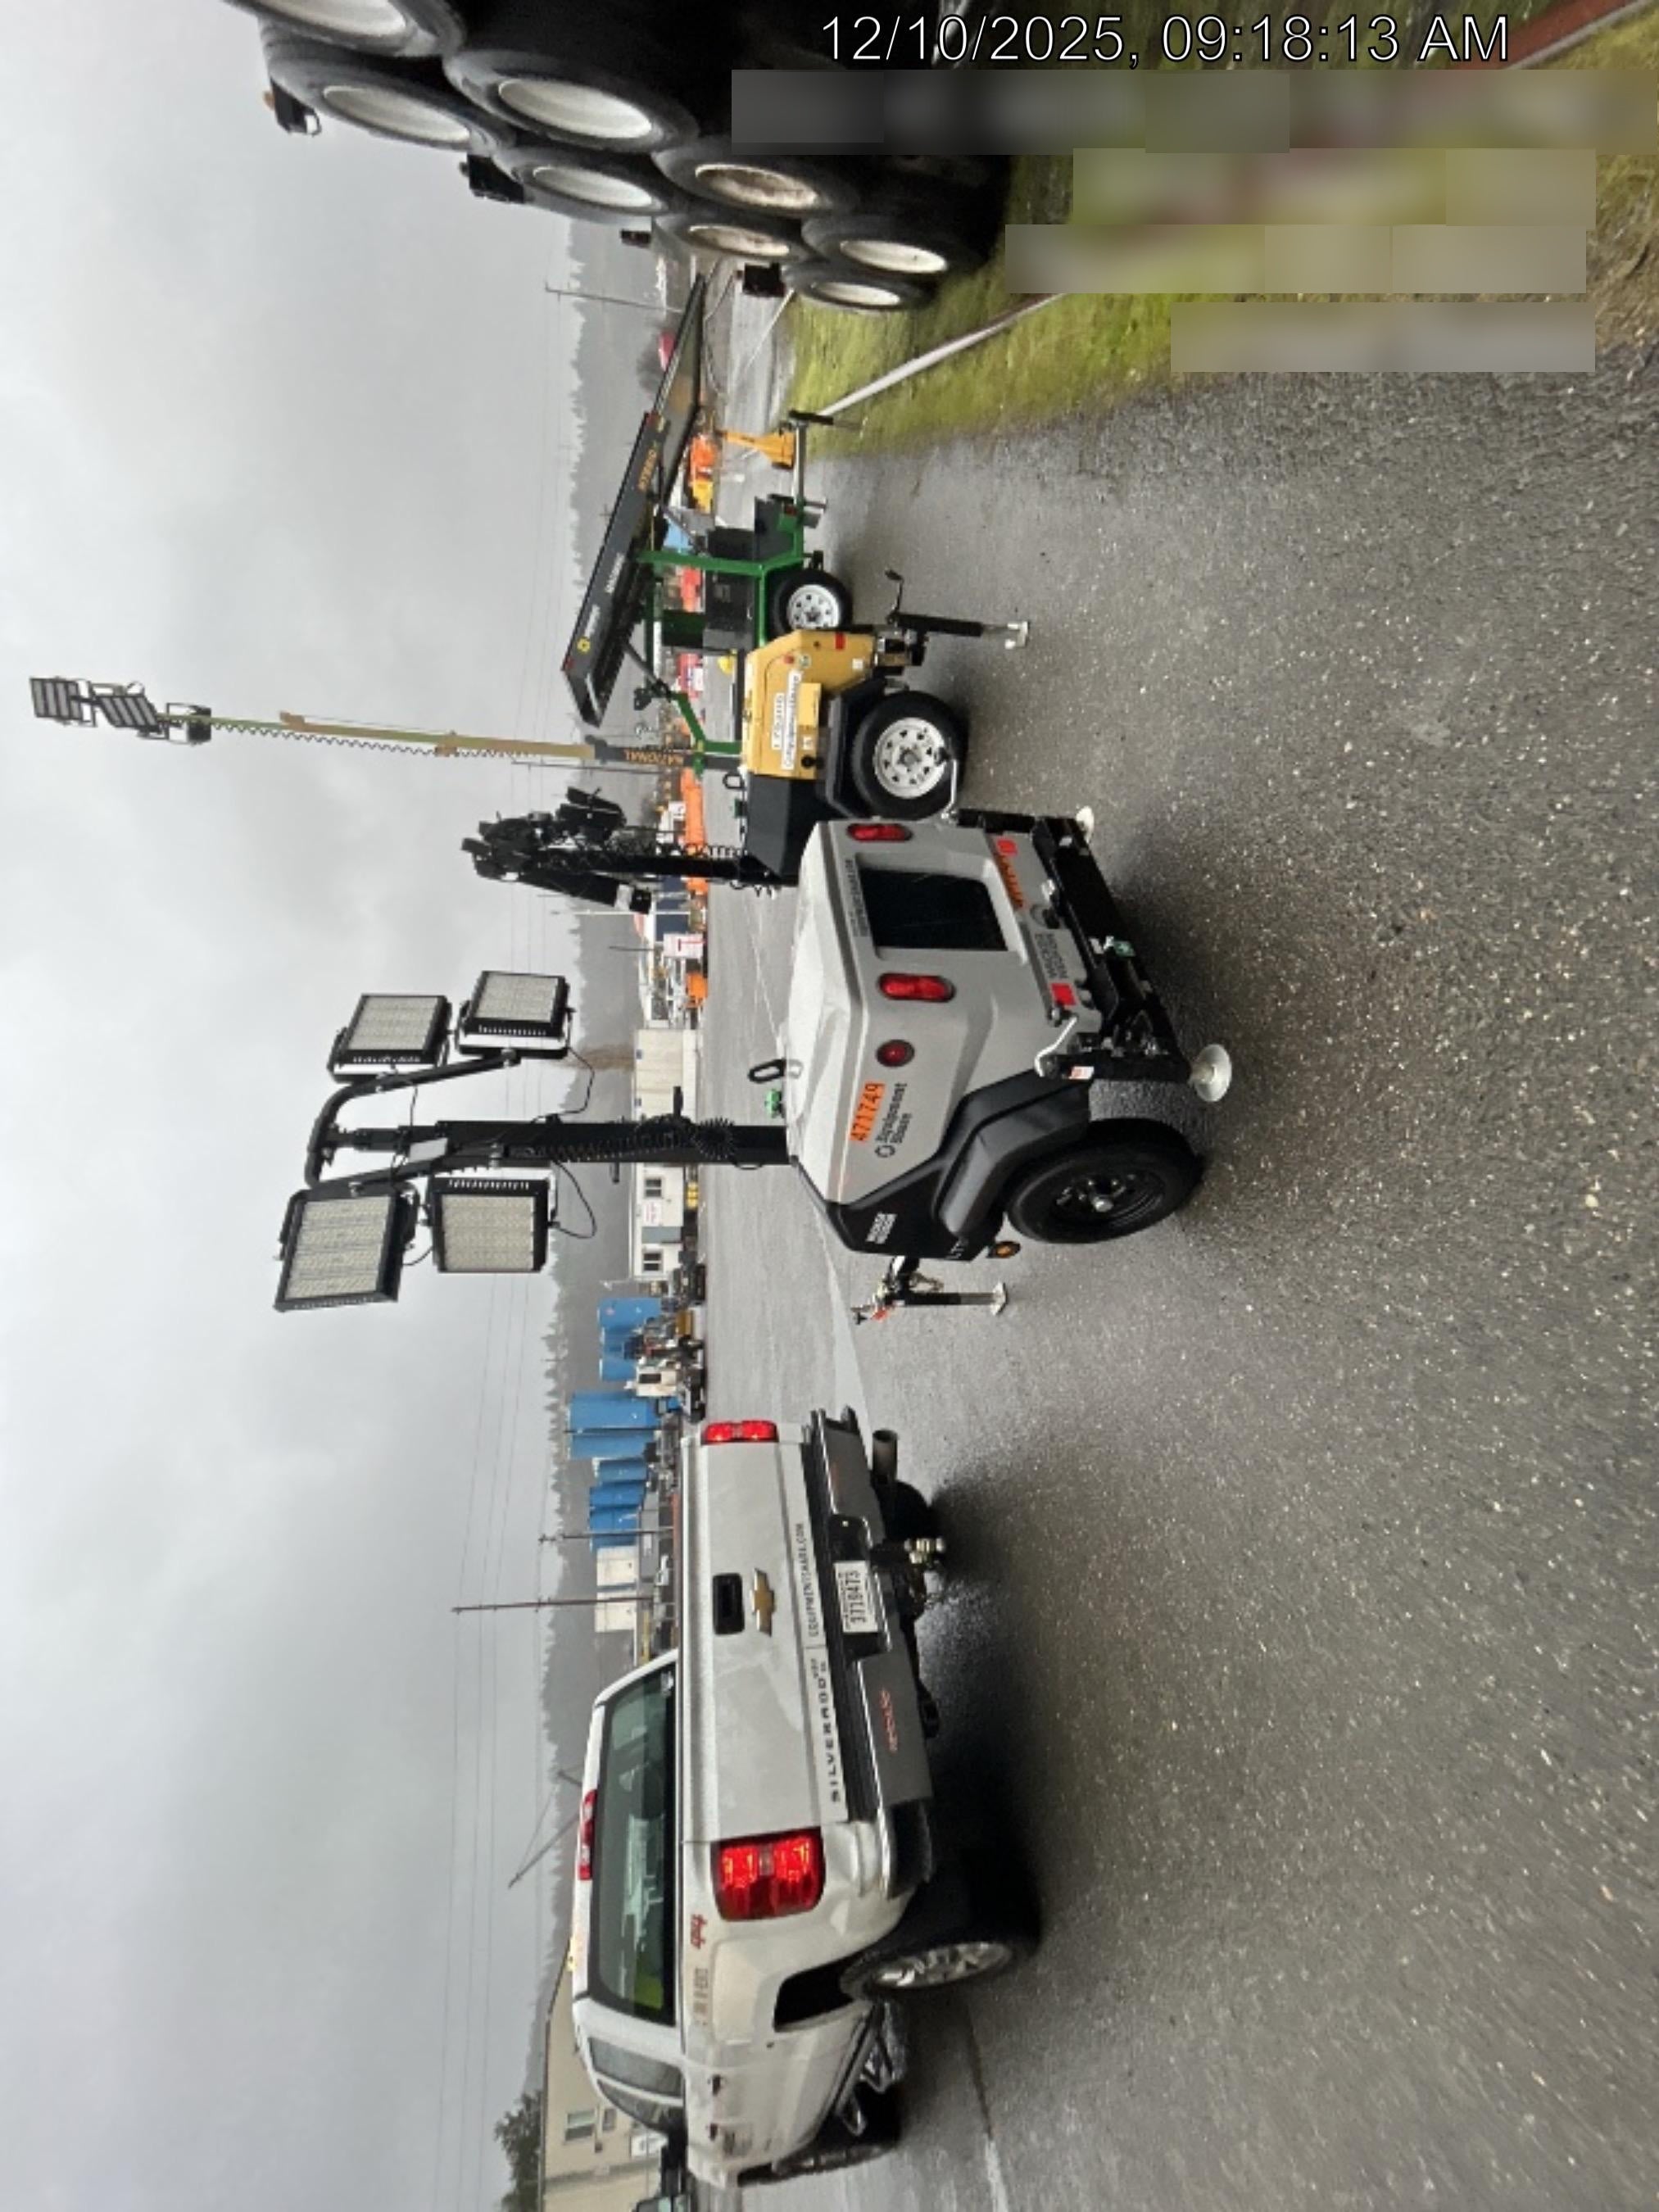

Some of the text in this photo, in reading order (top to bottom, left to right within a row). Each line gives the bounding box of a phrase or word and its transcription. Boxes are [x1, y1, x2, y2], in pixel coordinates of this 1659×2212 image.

[850, 1083, 885, 1141] 471749
[875, 1083, 908, 1143] Equipment
[818, 1677, 841, 1802] SILVERADO
